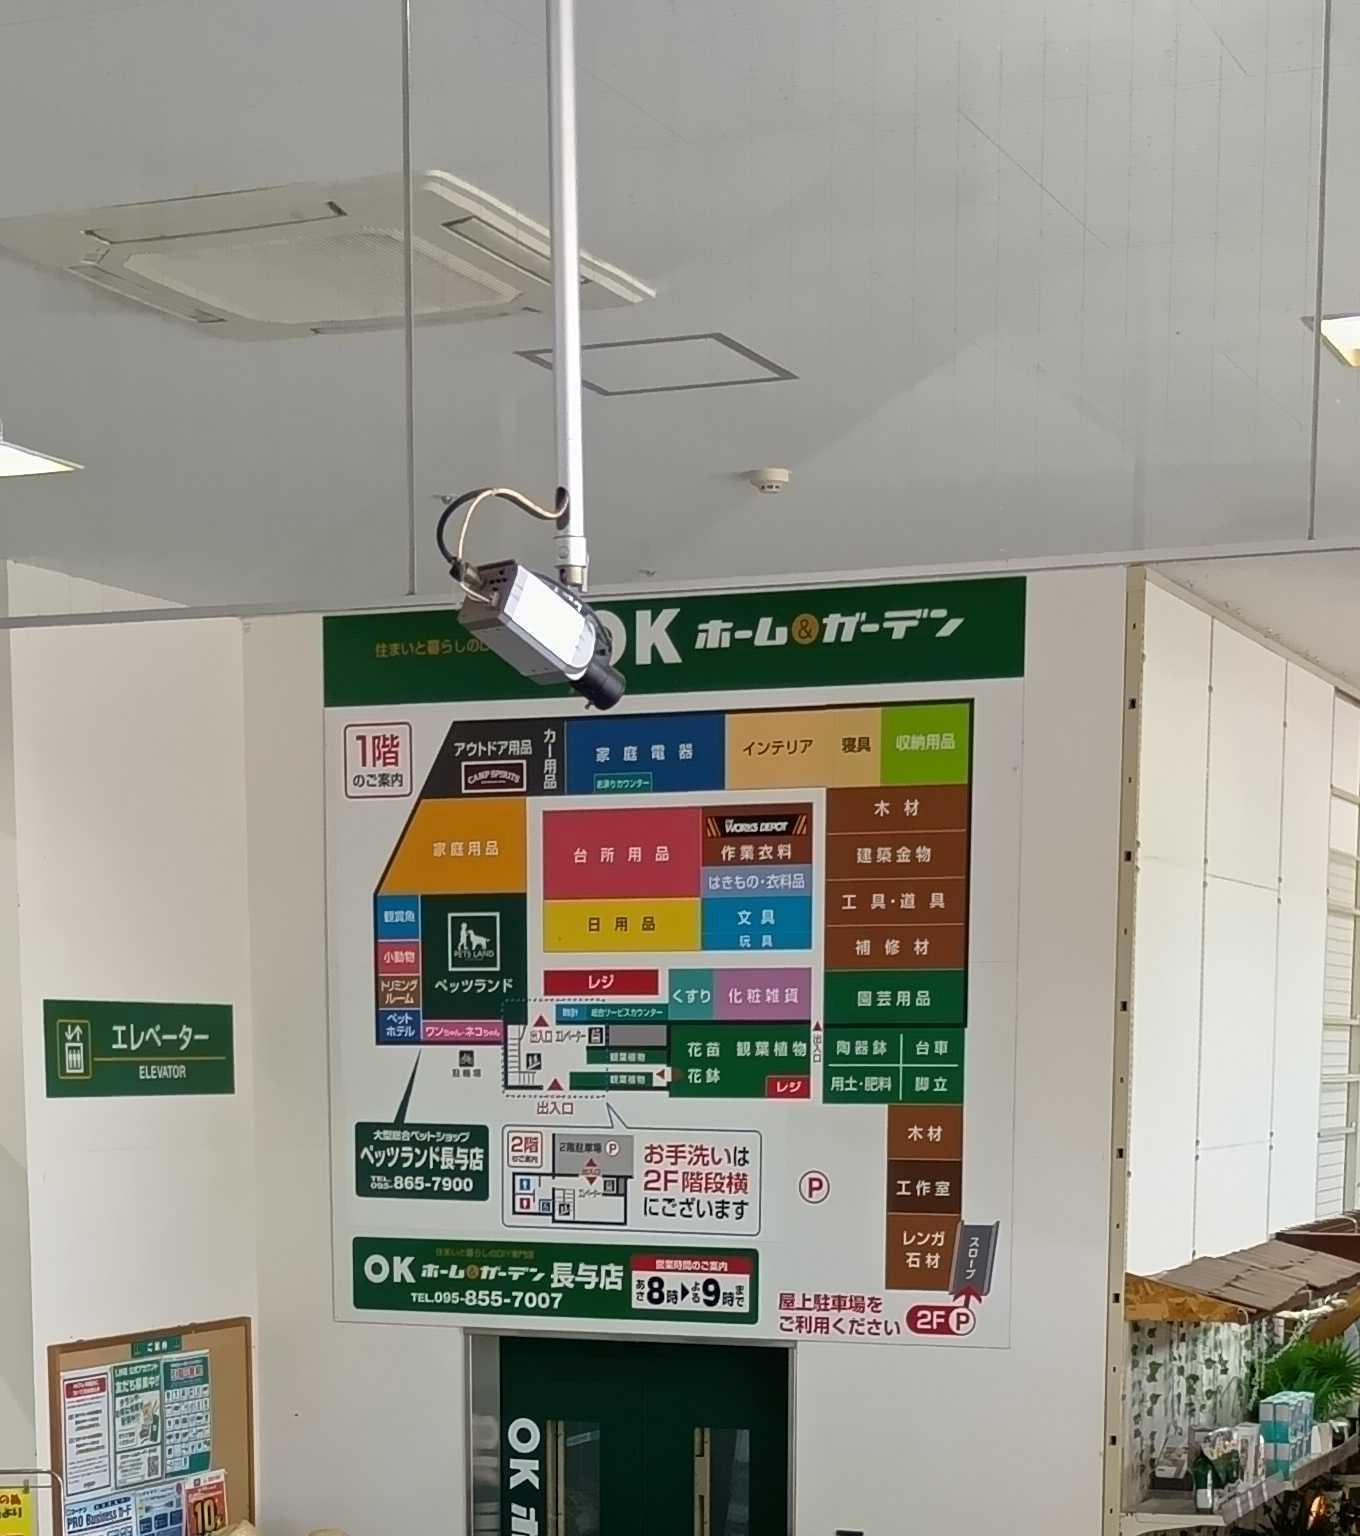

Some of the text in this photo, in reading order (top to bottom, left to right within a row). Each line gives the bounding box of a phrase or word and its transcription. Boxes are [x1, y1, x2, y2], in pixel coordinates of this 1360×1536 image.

[695, 607, 965, 649] ホーム&ガーデン
[354, 733, 401, 768] 1階
[453, 739, 533, 757] アウトドア用品
[742, 739, 814, 757] インテリア
[841, 736, 872, 753] 寝具
[895, 733, 956, 752] 収納用品
[543, 728, 557, 790] カー用品
[595, 743, 694, 763] 家庭電器
[352, 772, 404, 789] のご案内
[874, 799, 920, 817] 木材
[432, 841, 500, 858] 家庭用品
[573, 846, 670, 864] 台所用品
[720, 844, 792, 862] 作業衣料
[856, 846, 932, 864] 建築金物
[708, 873, 805, 890] はきもの・衣料品
[841, 892, 946, 911] 工具・道具
[587, 916, 657, 933] 日用品
[737, 909, 776, 926] 文具
[739, 934, 774, 948] 玩具
[855, 938, 930, 957] 補修材
[383, 951, 416, 964] 小動物
[380, 979, 419, 992] トリミング
[434, 978, 514, 993] ペッツランド
[588, 974, 615, 990] レジ
[384, 993, 415, 1004] ルーム
[672, 988, 712, 1004] くすり
[728, 987, 800, 1005] 化粧雑貨
[857, 989, 932, 1007] 園芸用品
[386, 1013, 413, 1024] ペット
[111, 1024, 210, 1051] エレベーター
[386, 1025, 416, 1037] ホテル
[687, 1041, 721, 1058] 花苗
[736, 1040, 808, 1058] 観葉植物
[915, 1040, 949, 1056] 台車
[138, 1065, 187, 1080] ELEVATOR
[687, 1067, 721, 1084] 花鉢
[775, 1080, 802, 1094] レジ
[830, 1076, 892, 1092] 用土・肥料
[914, 1076, 948, 1092] 脚立
[536, 1101, 574, 1116] 出入口
[907, 1125, 943, 1142] 木材
[511, 1135, 539, 1153] 2階
[360, 1145, 484, 1171] ペッツランド長与店
[643, 1144, 750, 1167] お手洗いは
[393, 1175, 474, 1192] 865-7900
[643, 1169, 749, 1195] 2F階段横
[807, 1177, 823, 1198] P
[895, 1180, 951, 1197] 工作室
[643, 1198, 750, 1221] にございます
[902, 1230, 946, 1247] レンガ
[905, 1252, 942, 1269] 石材
[964, 1236, 980, 1281] スロープ
[363, 1253, 417, 1285] OK
[550, 1262, 625, 1291] 長与店
[778, 1292, 883, 1315] 屋上駐車場を
[778, 1315, 901, 1337] ご利用ください
[915, 1310, 945, 1331] 2F
[507, 1417, 541, 1490] OK
[67, 1516, 84, 1530] PRO
